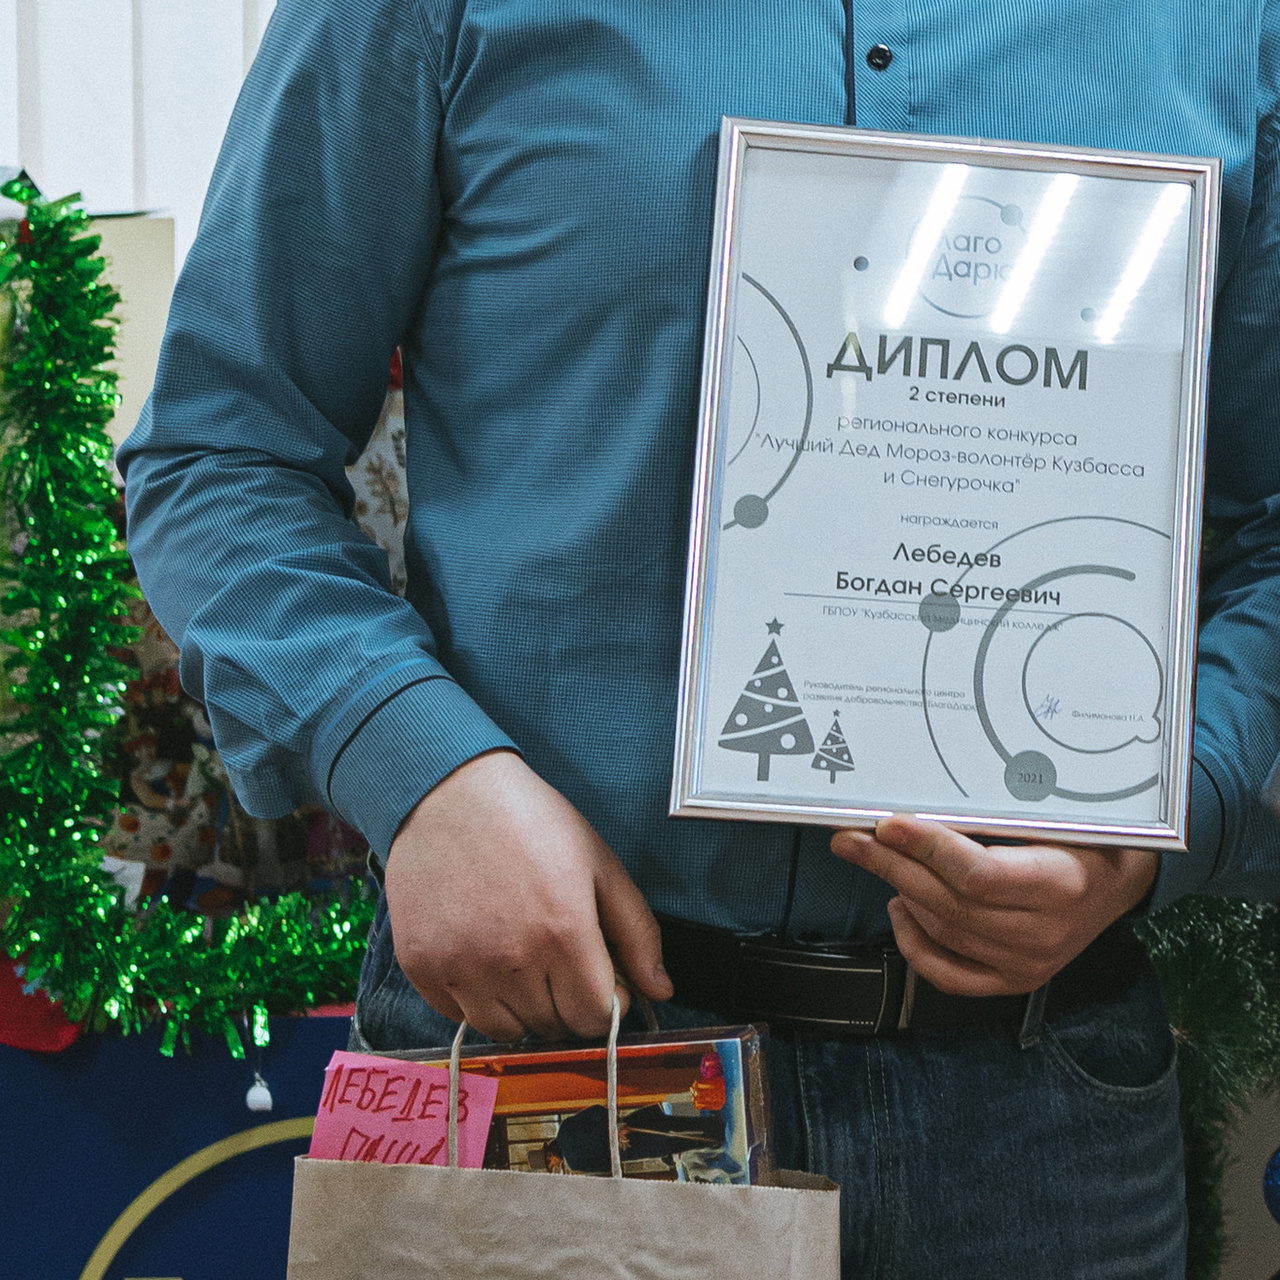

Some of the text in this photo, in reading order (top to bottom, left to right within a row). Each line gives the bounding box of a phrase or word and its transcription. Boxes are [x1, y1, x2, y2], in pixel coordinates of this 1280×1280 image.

[826, 331, 1089, 391] ДИПЛОМ
[908, 386, 1006, 408] 2 степени
[837, 416, 1078, 447] регионального конкурса
[839, 439, 881, 459] Дед
[886, 442, 1047, 472] Мороз-волонтёр
[1052, 455, 1145, 478] Кузбасса
[883, 469, 1021, 494] и Снегурочка"
[900, 514, 999, 530] награждается
[892, 542, 1002, 569] Лебедев
[836, 571, 1061, 606] Богдан Сергеевич
[1017, 772, 1044, 785] 2021
